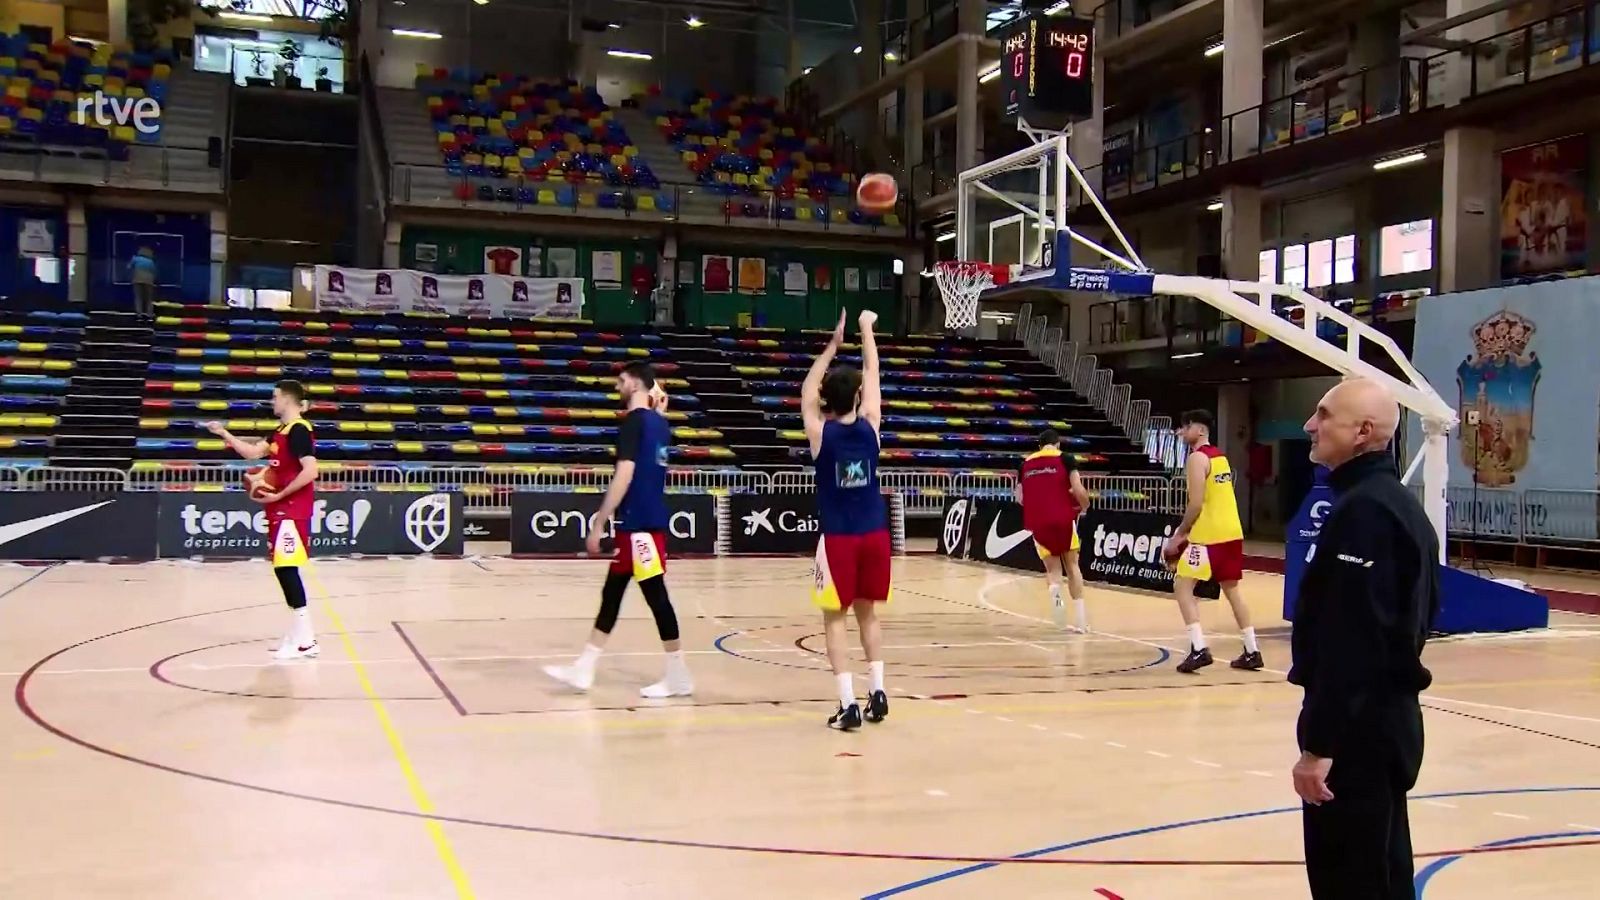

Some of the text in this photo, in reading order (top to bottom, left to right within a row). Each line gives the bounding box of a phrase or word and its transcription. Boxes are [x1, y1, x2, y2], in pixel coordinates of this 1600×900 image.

[1051, 32, 1088, 51] 14:42
[1067, 53, 1082, 76] 0
[180, 499, 372, 545] tenefe!
[184, 536, 261, 549] despierta
[1093, 523, 1173, 564] teneri
[1090, 558, 1178, 581] despierta emocio
